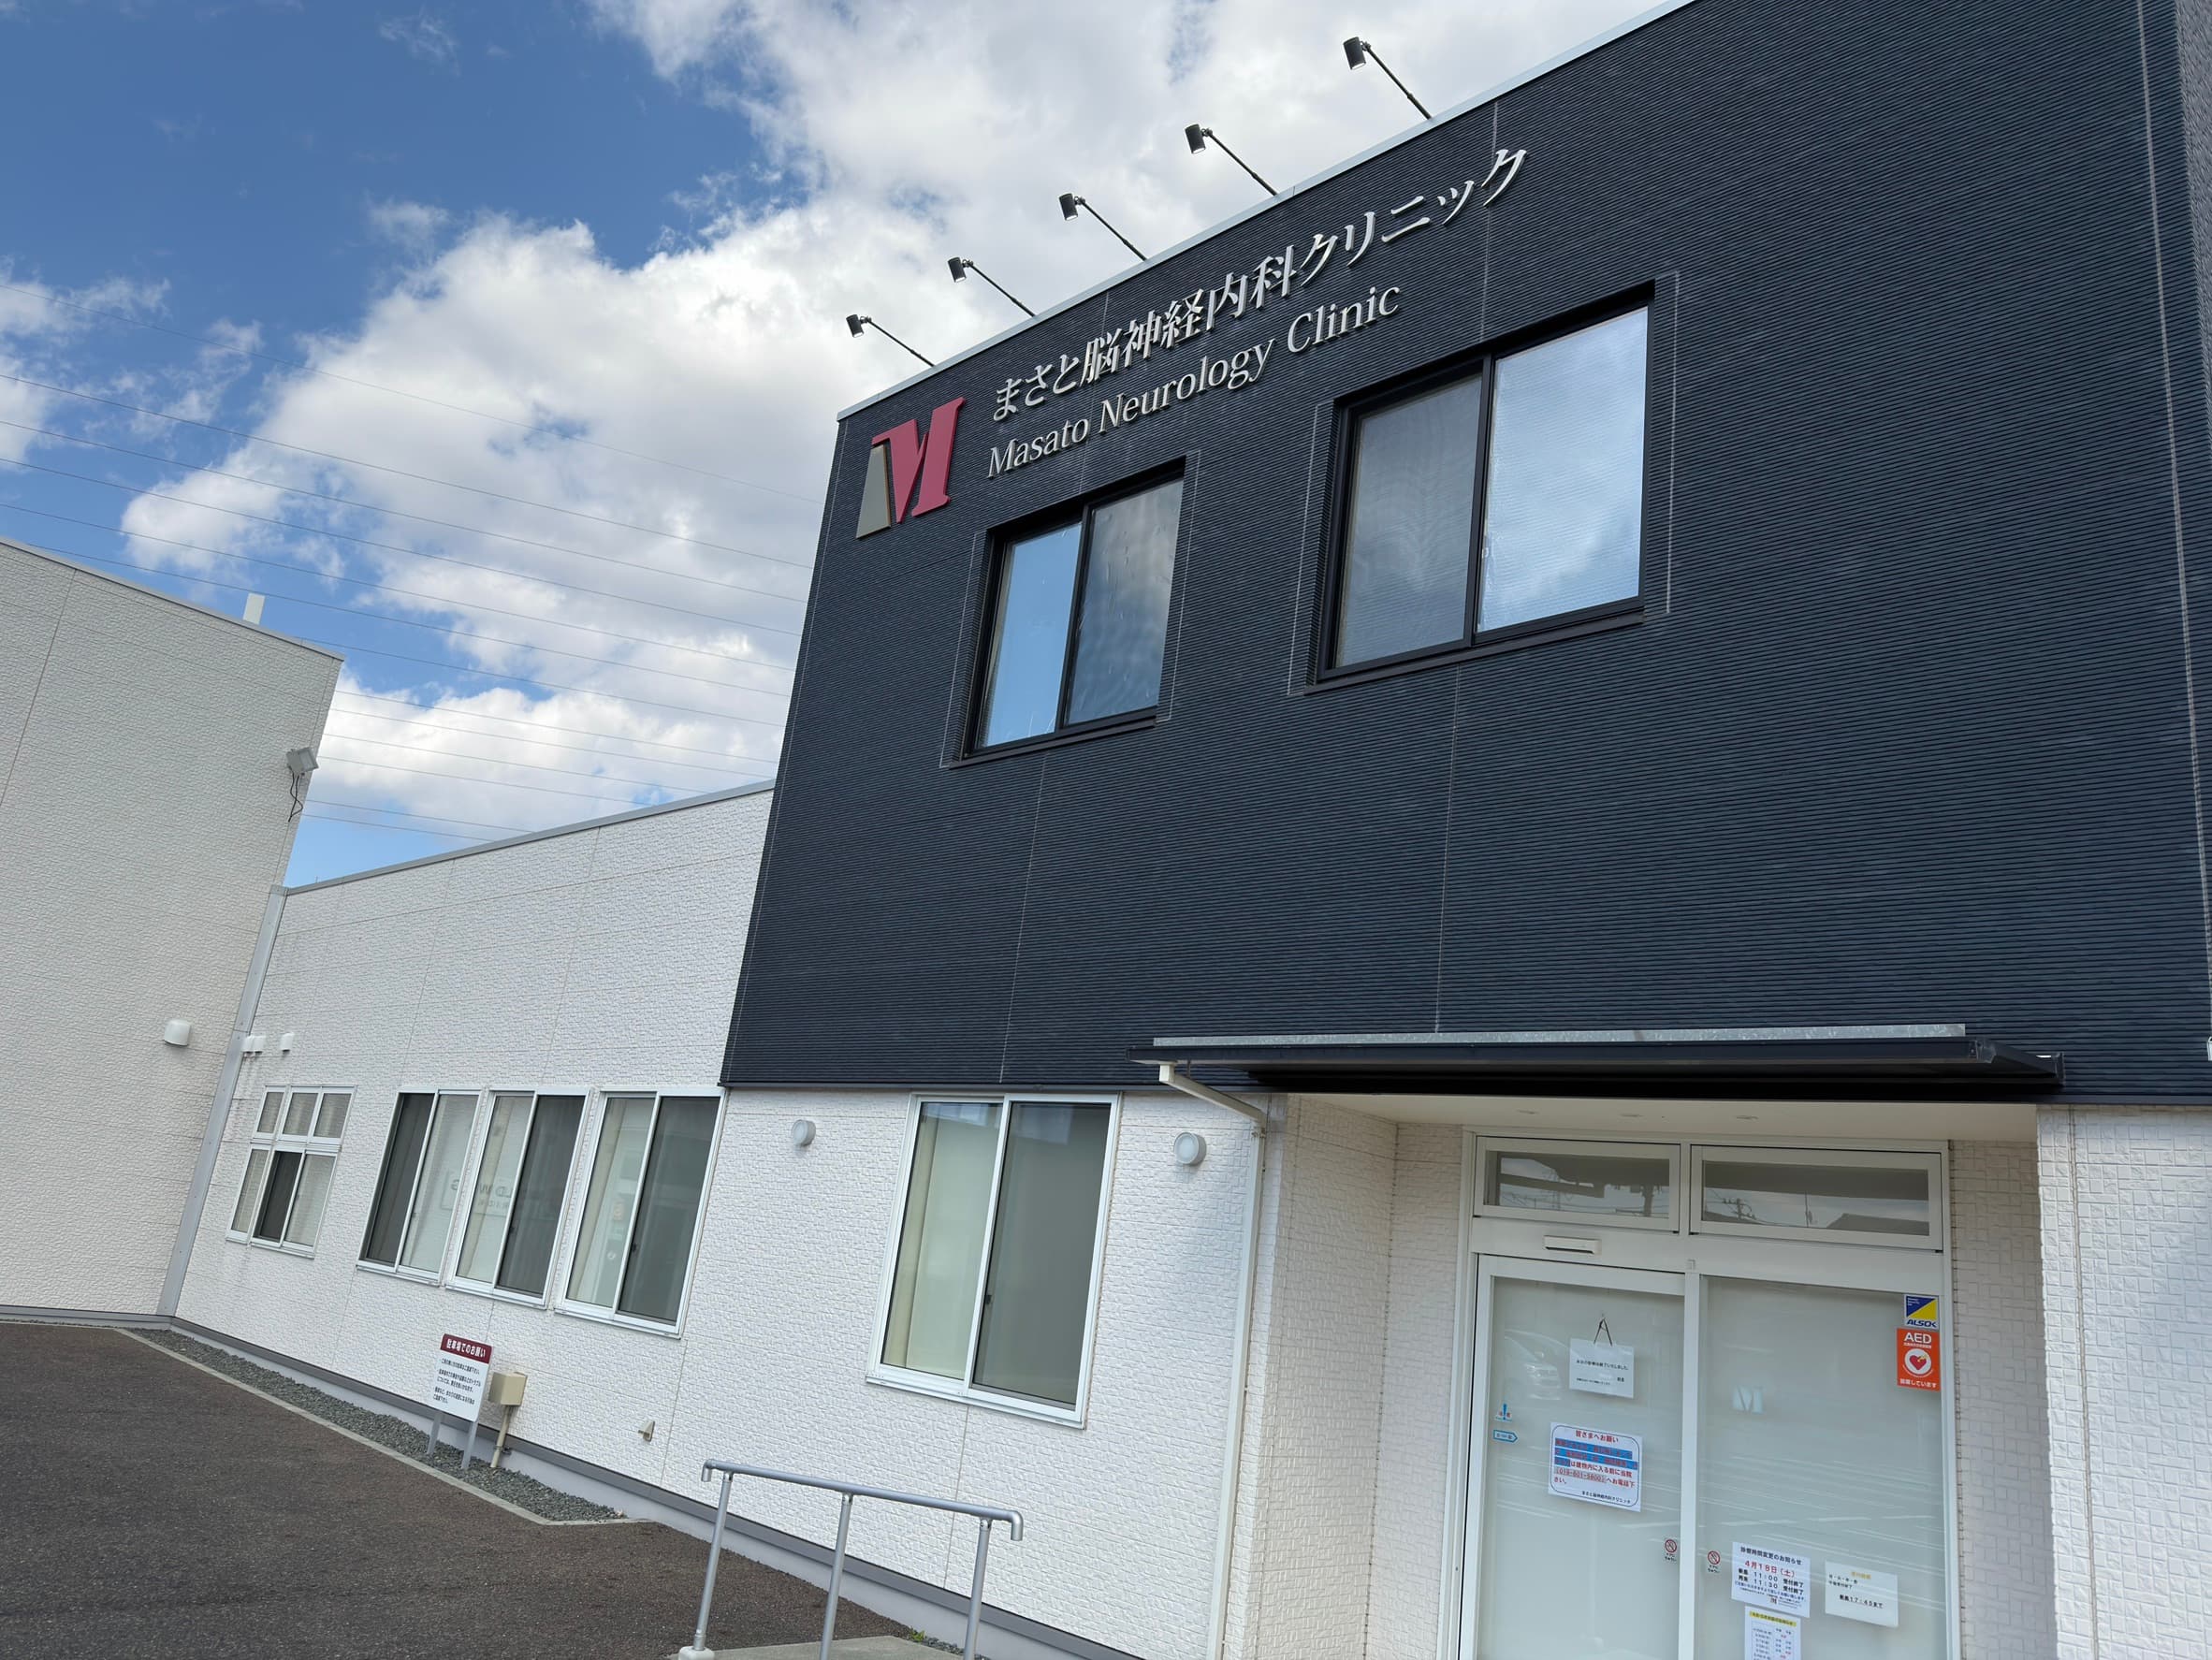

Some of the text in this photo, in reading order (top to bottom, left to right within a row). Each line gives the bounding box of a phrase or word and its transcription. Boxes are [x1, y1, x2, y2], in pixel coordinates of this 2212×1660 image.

[993, 149, 1528, 422] まさと脳神経内科クリニック
[987, 284, 1401, 479] Masato Neurology Clinic
[1907, 1319, 1937, 1328] ALSOK
[1903, 1332, 1932, 1344] AED
[1576, 1430, 1619, 1443] 皆さまへお願い
